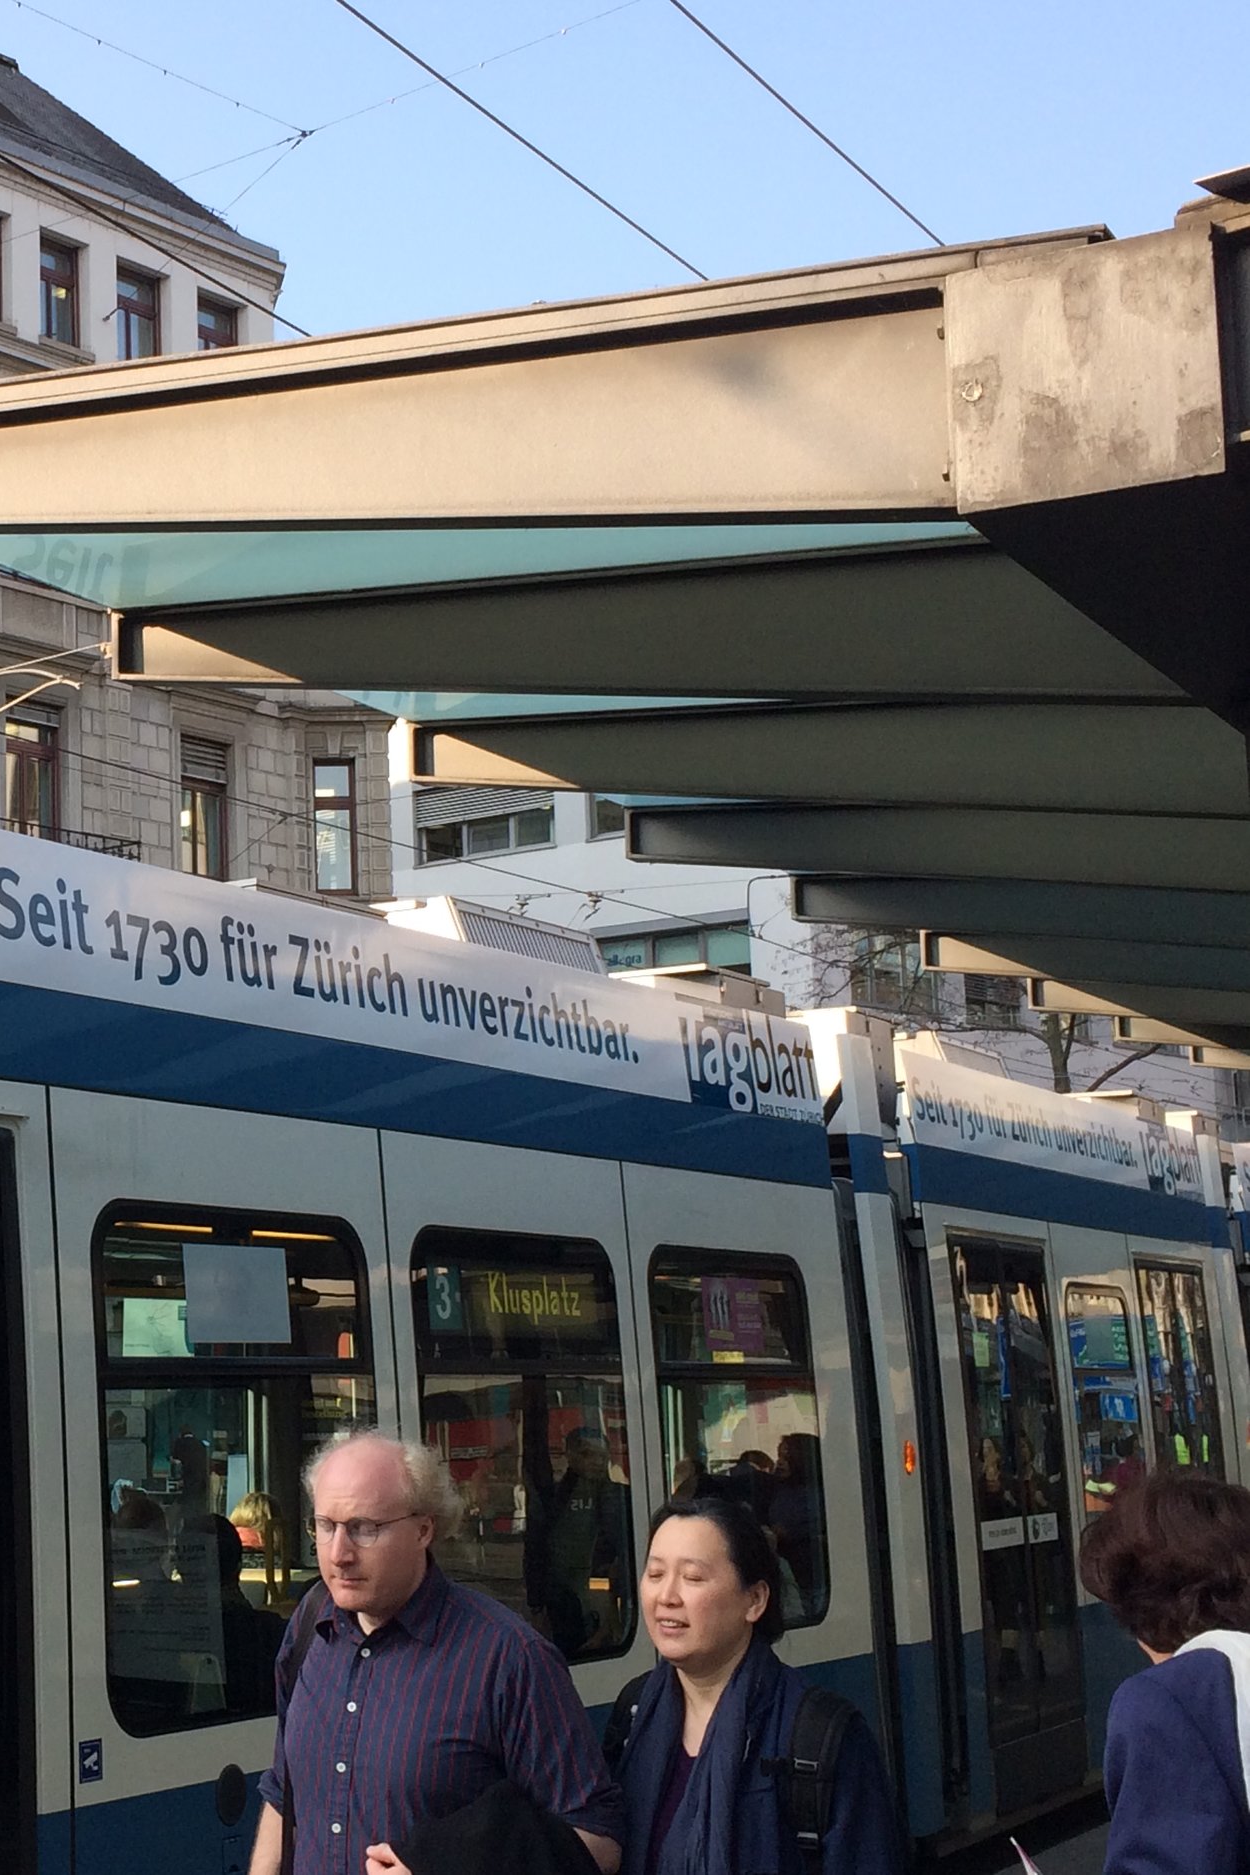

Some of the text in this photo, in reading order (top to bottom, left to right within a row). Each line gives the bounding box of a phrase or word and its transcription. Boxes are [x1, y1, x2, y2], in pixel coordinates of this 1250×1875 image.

[105, 910, 208, 986] 1730
[220, 915, 278, 992] für
[288, 934, 408, 1017] Zürich
[418, 979, 640, 1064] unverzichtbar.
[678, 1004, 818, 1113] Tagblatt
[911, 1076, 948, 1126] Seit
[948, 1097, 984, 1141] 1730
[487, 1270, 582, 1326] Klusplatz
